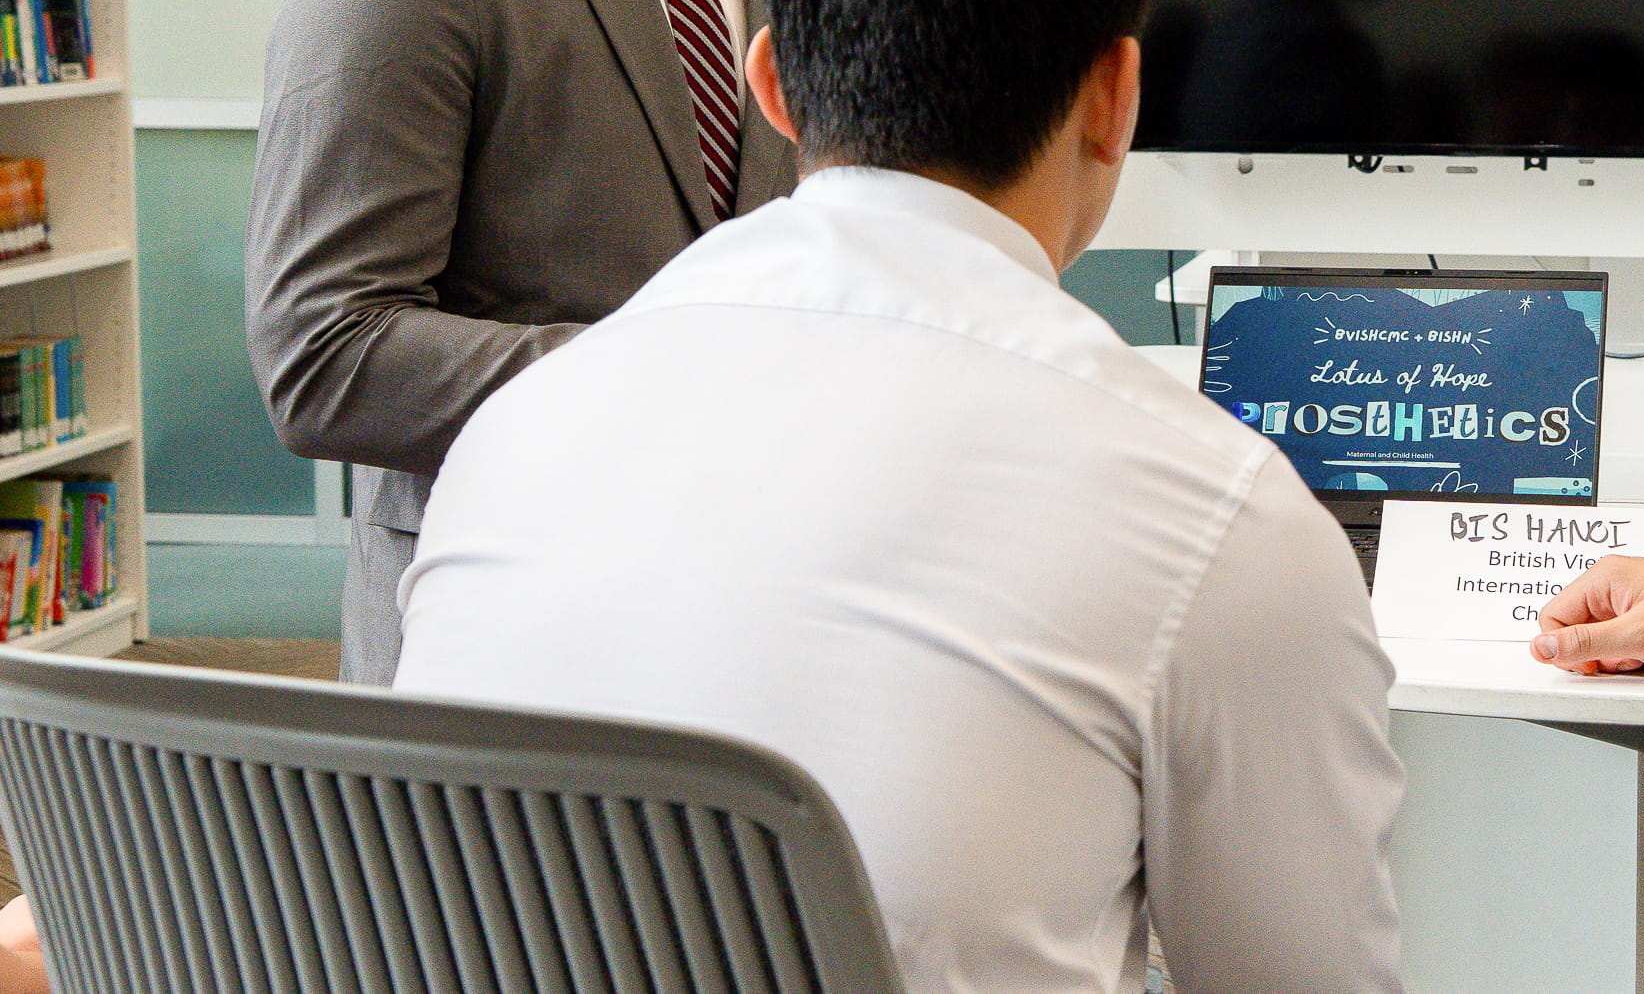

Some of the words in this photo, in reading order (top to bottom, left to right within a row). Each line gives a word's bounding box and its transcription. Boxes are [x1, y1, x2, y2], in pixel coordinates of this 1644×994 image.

[1334, 328, 1410, 343] BVISHCMC
[1413, 332, 1424, 343] +
[1427, 330, 1473, 345] BISHN
[1310, 359, 1388, 386] Lotus
[1396, 364, 1422, 394] of
[1430, 363, 1493, 392] Hope
[1450, 512, 1509, 542] BIS
[1526, 513, 1632, 549] HANOI
[1488, 550, 1555, 569] British
[1456, 576, 1565, 596] Internatio
[1512, 605, 1539, 621] Ch
